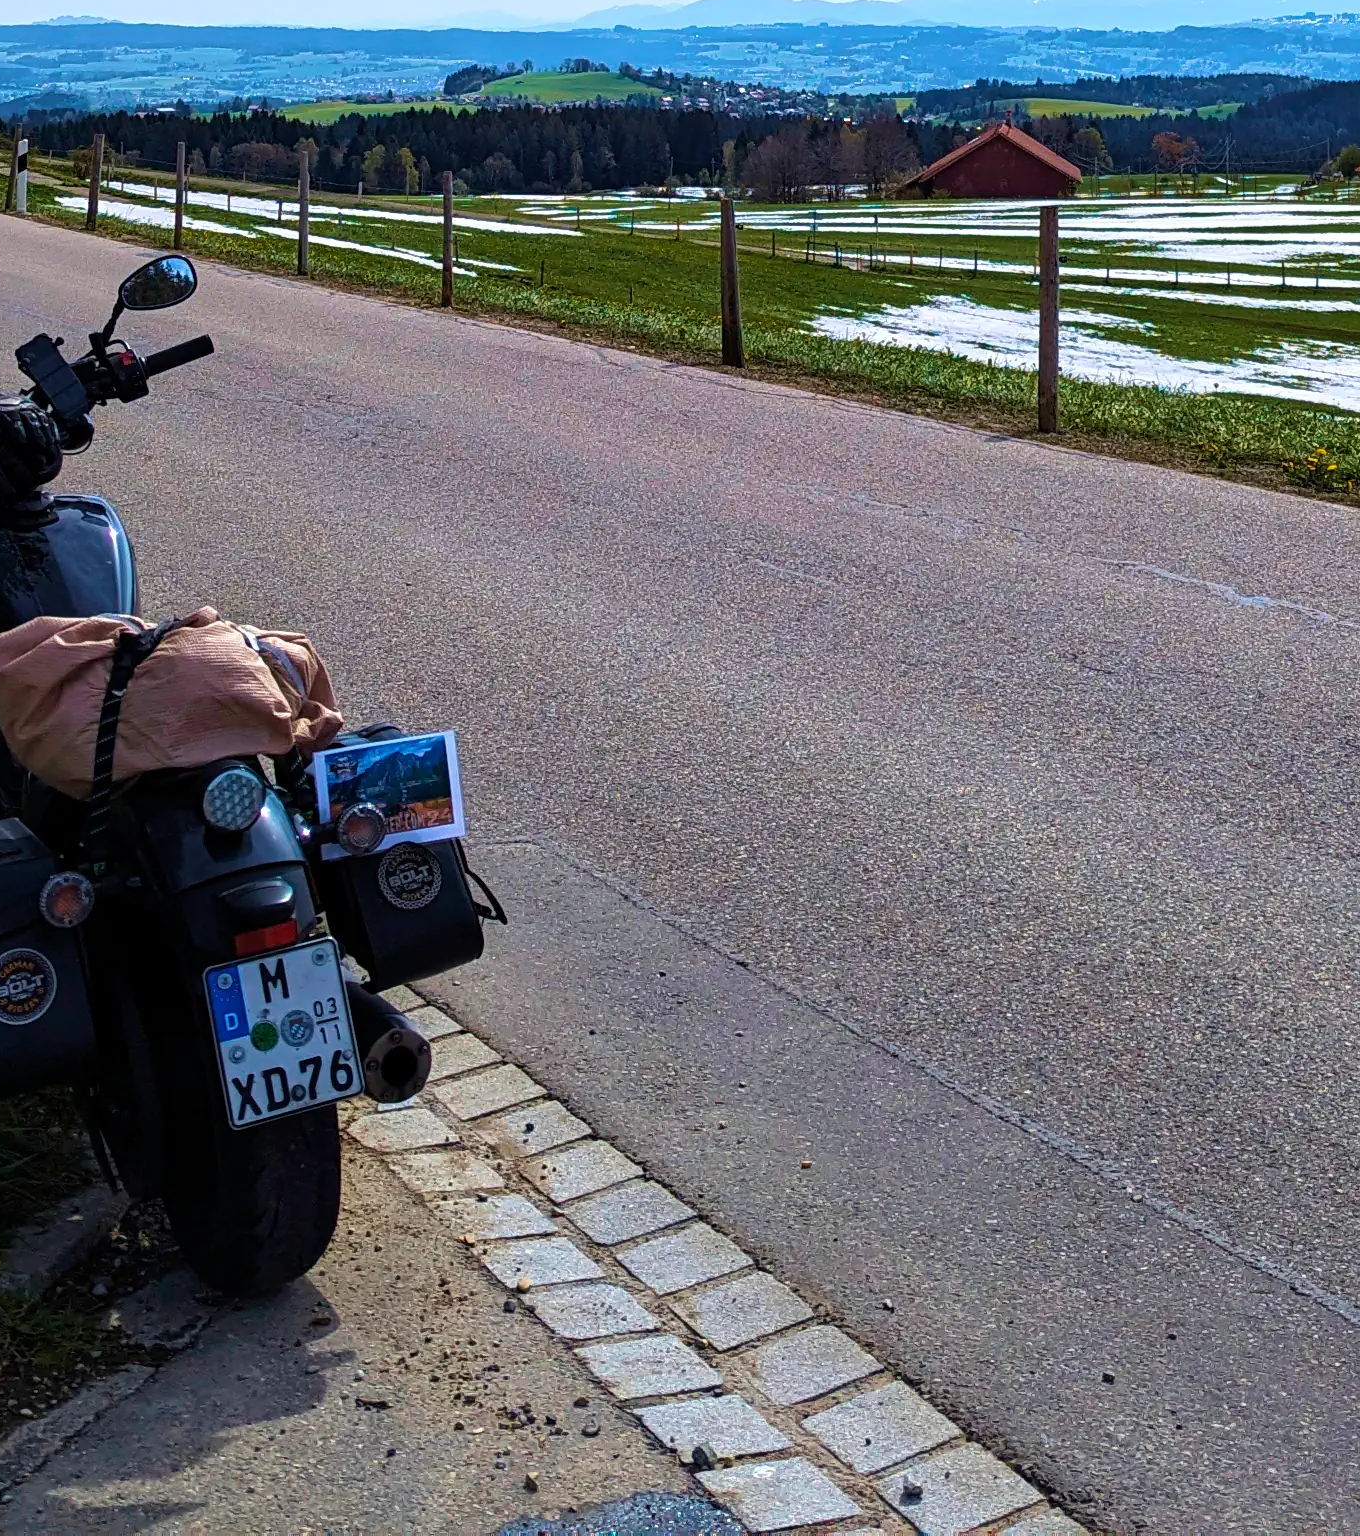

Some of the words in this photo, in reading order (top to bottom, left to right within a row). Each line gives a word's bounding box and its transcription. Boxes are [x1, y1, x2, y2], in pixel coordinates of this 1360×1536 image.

[389, 865, 429, 887] BOLT
[259, 958, 289, 1003] M
[313, 997, 338, 1017] 03
[225, 1013, 239, 1031] D
